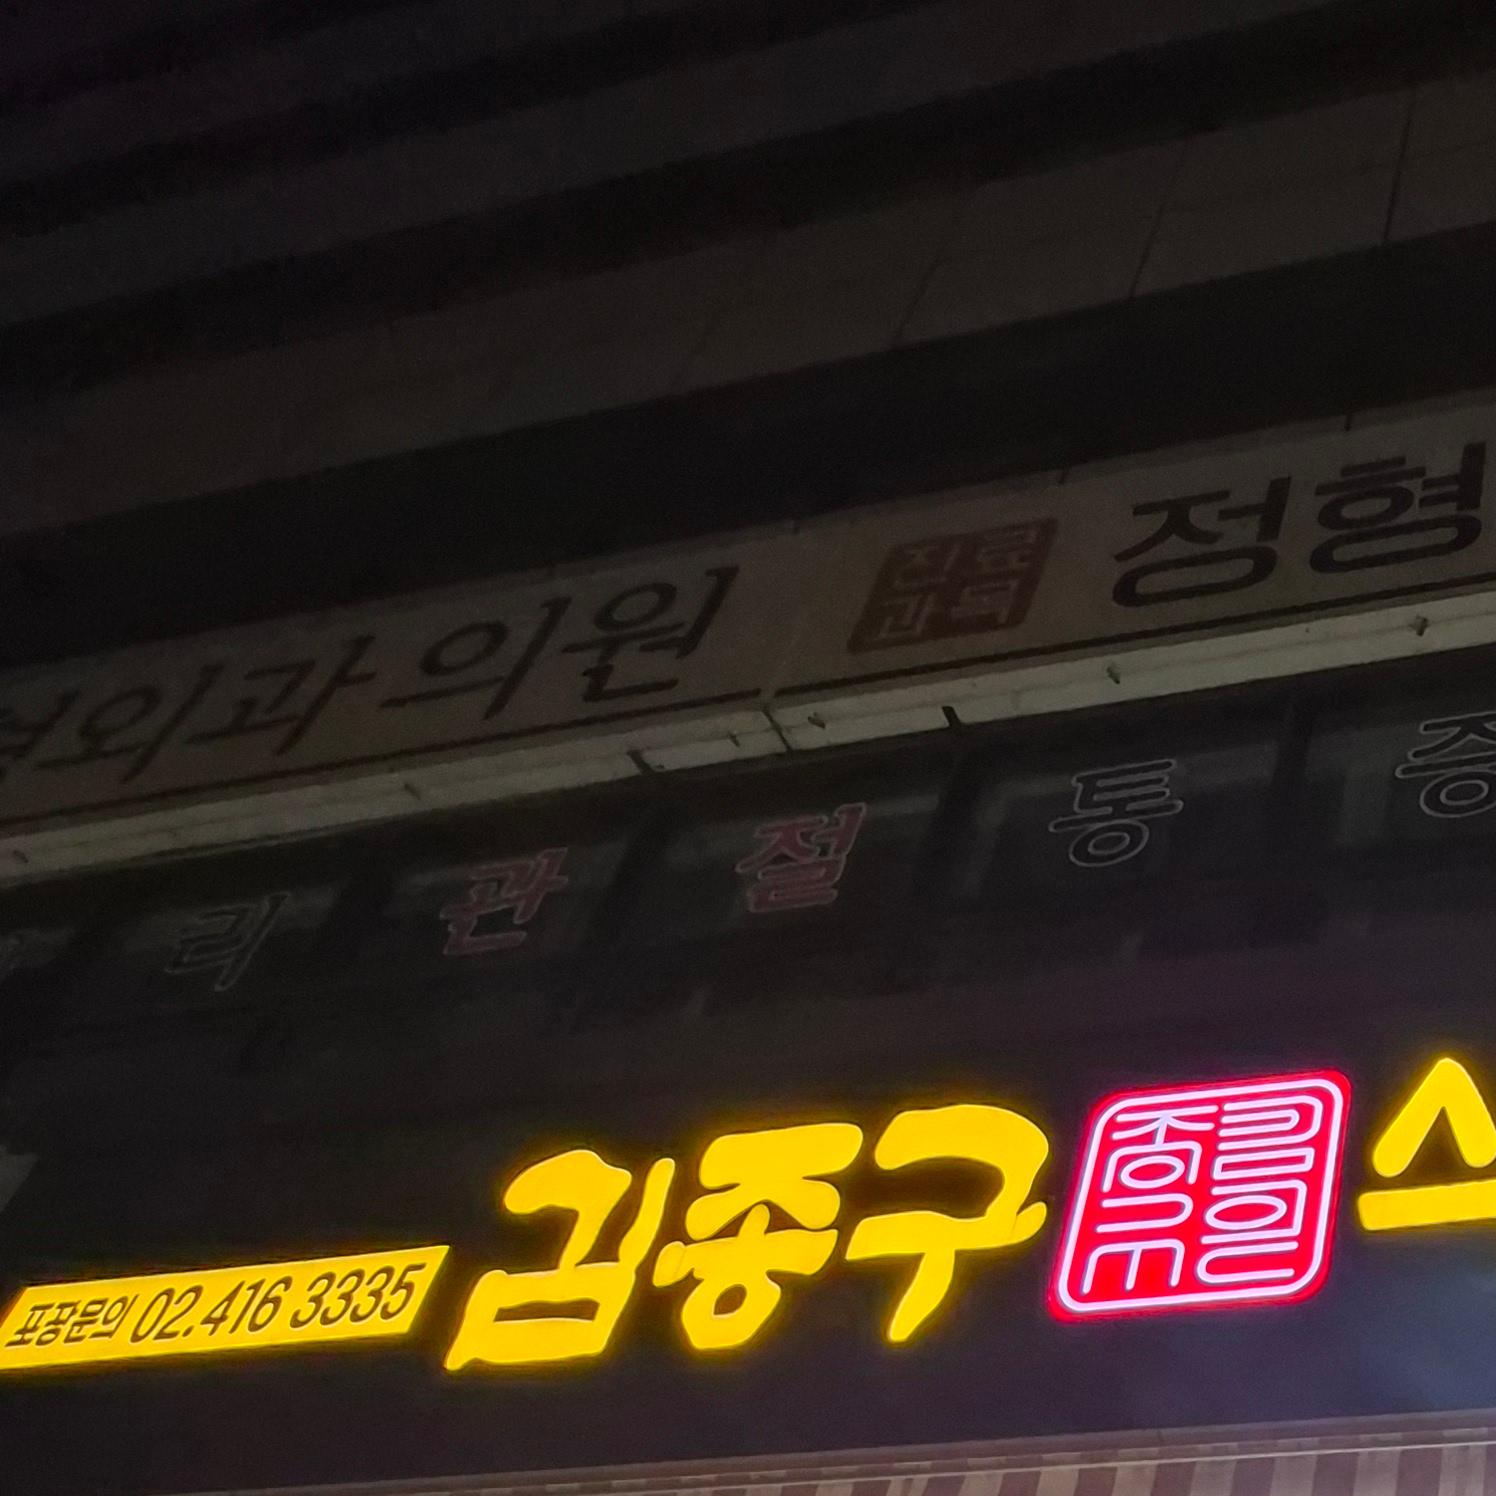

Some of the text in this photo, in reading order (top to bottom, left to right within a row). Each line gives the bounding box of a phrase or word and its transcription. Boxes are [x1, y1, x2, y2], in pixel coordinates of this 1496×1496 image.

[5, 1261, 427, 1348] 포장문의 02.416 3335
[446, 1103, 1050, 1370] 김종구
